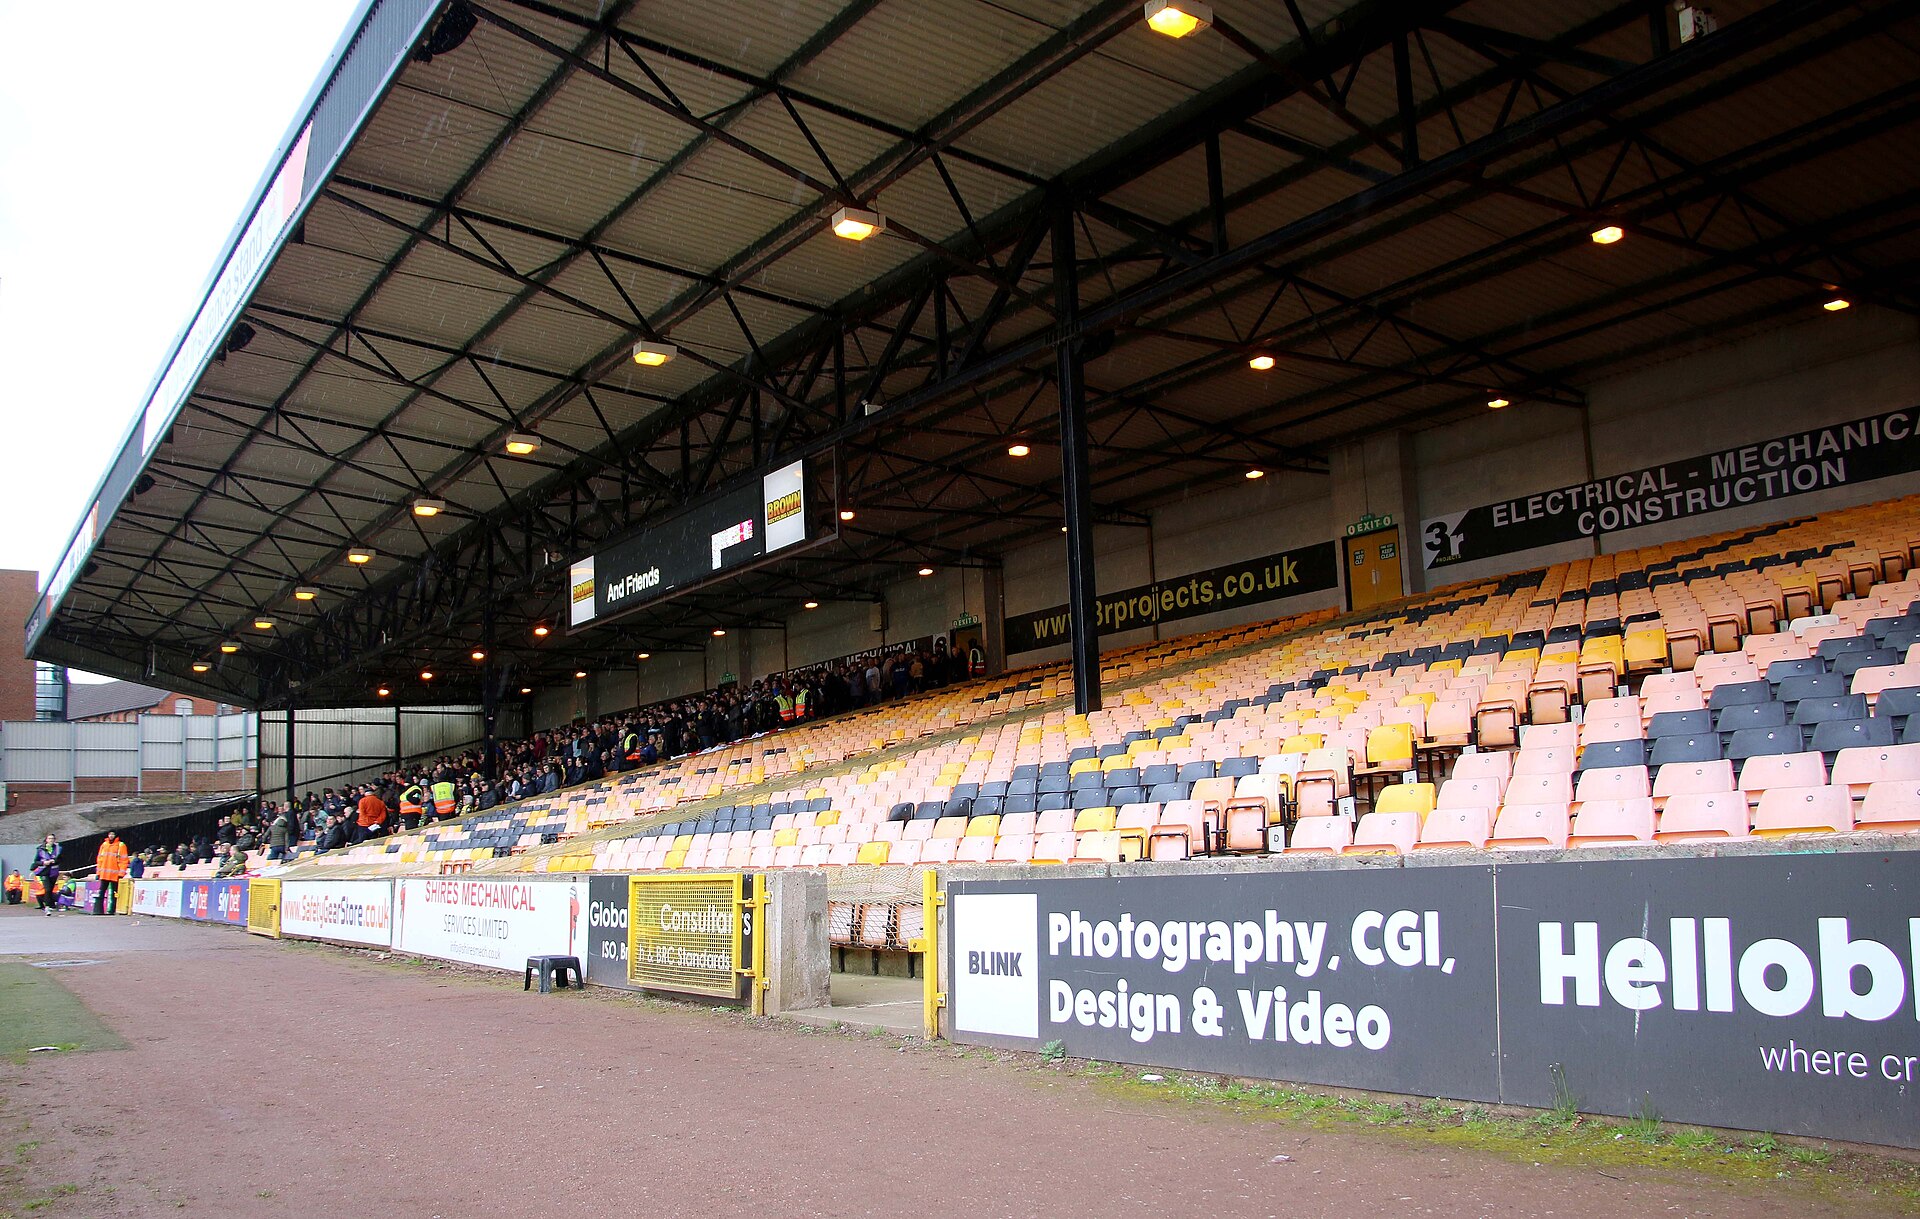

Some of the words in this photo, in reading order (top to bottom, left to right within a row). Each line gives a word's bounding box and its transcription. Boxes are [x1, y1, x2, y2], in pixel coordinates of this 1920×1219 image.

[232, 210, 265, 296] stand
[1493, 467, 1678, 528] ELECTRICAL
[1711, 413, 1920, 479] MECHANIC
[767, 489, 801, 519] BROWN
[1578, 457, 1846, 535] CONSTRUCTION
[1357, 518, 1380, 532] EXIT
[607, 582, 624, 603] And
[626, 566, 660, 594] Friends
[190, 887, 198, 914] sky
[218, 887, 229, 917] sky
[229, 889, 240, 912] bet
[283, 894, 389, 929] www.SafetyGearStore.co.uk
[425, 881, 459, 905] SHIRES
[462, 882, 536, 912] MECHANICAL
[443, 914, 477, 936] SERVICES
[478, 917, 509, 940] LIMITED
[590, 901, 627, 928] Globa
[602, 940, 619, 961] ISO,
[678, 947, 730, 971] Standards
[1048, 909, 1341, 978] Photography,
[1351, 910, 1456, 975] CGI,
[968, 950, 1022, 977] BLINK
[1049, 978, 1181, 1044] Design
[1190, 986, 1223, 1037] &
[1237, 986, 1392, 1051] Video
[1760, 1040, 1868, 1078] where
